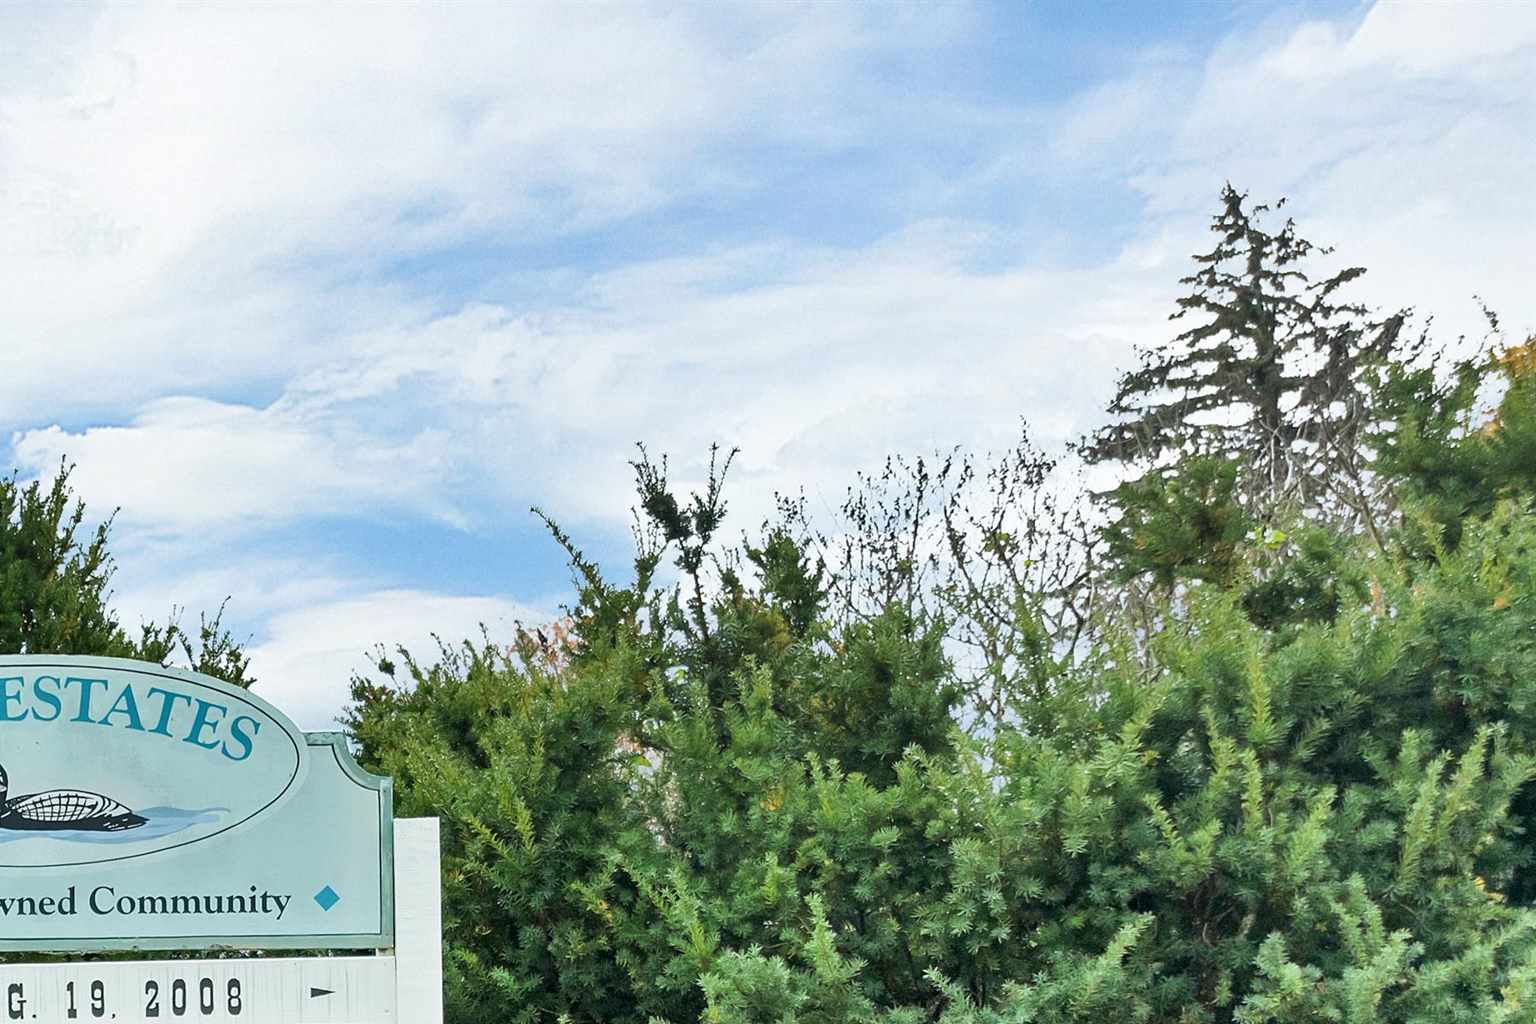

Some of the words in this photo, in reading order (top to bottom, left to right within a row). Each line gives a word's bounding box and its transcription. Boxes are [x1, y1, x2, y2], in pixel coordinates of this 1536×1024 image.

[89, 885, 292, 920] Community
[67, 980, 115, 1019] 19,
[145, 978, 241, 1017] 2008
